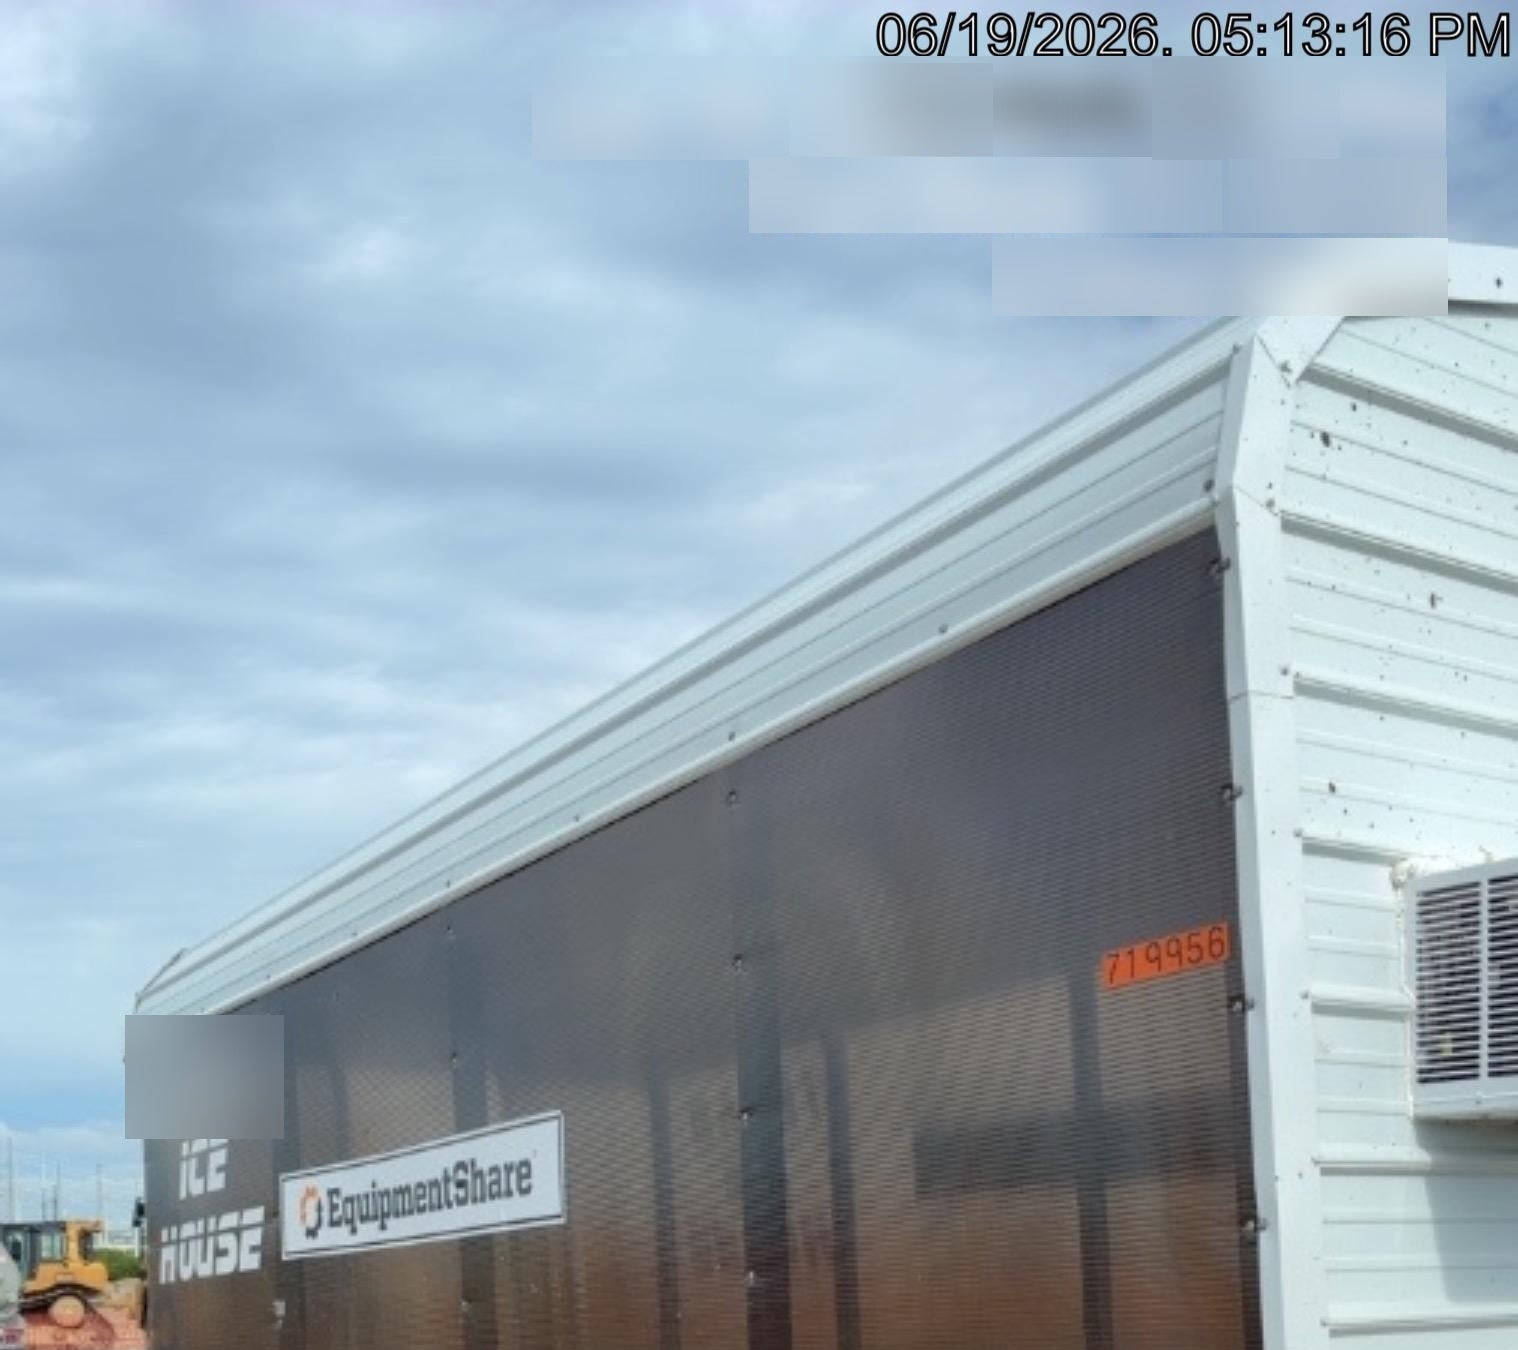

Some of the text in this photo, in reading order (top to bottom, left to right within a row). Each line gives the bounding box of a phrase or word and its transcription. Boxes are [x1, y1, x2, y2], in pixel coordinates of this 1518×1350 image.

[1105, 926, 1225, 985] 719956
[178, 1138, 229, 1200] ICE
[326, 1155, 533, 1236] EquipmentShare
[158, 1206, 265, 1285] HOUSE
